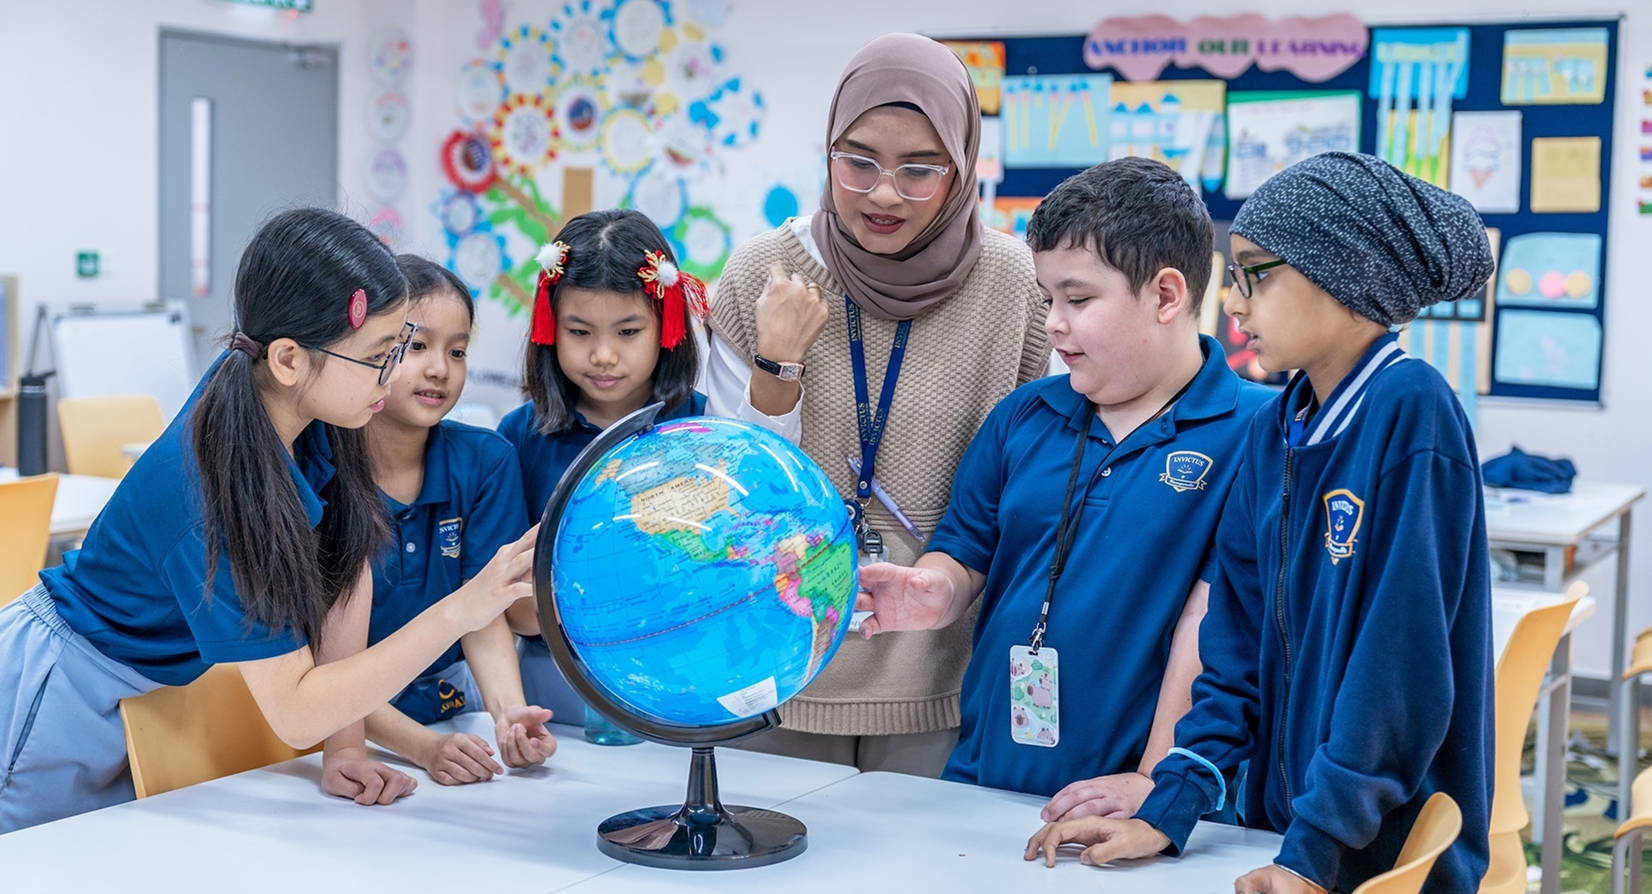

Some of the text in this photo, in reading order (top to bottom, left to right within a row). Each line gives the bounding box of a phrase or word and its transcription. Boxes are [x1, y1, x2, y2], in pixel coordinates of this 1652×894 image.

[1197, 37, 1250, 56] OUR
[1256, 38, 1367, 58] LEARNING
[847, 303, 858, 342] INVICTUS
[858, 402, 869, 442] INVICTUS
[869, 407, 884, 446] INVICTUS
[1173, 456, 1205, 467] INVICTUS
[640, 490, 665, 502] NORTH
